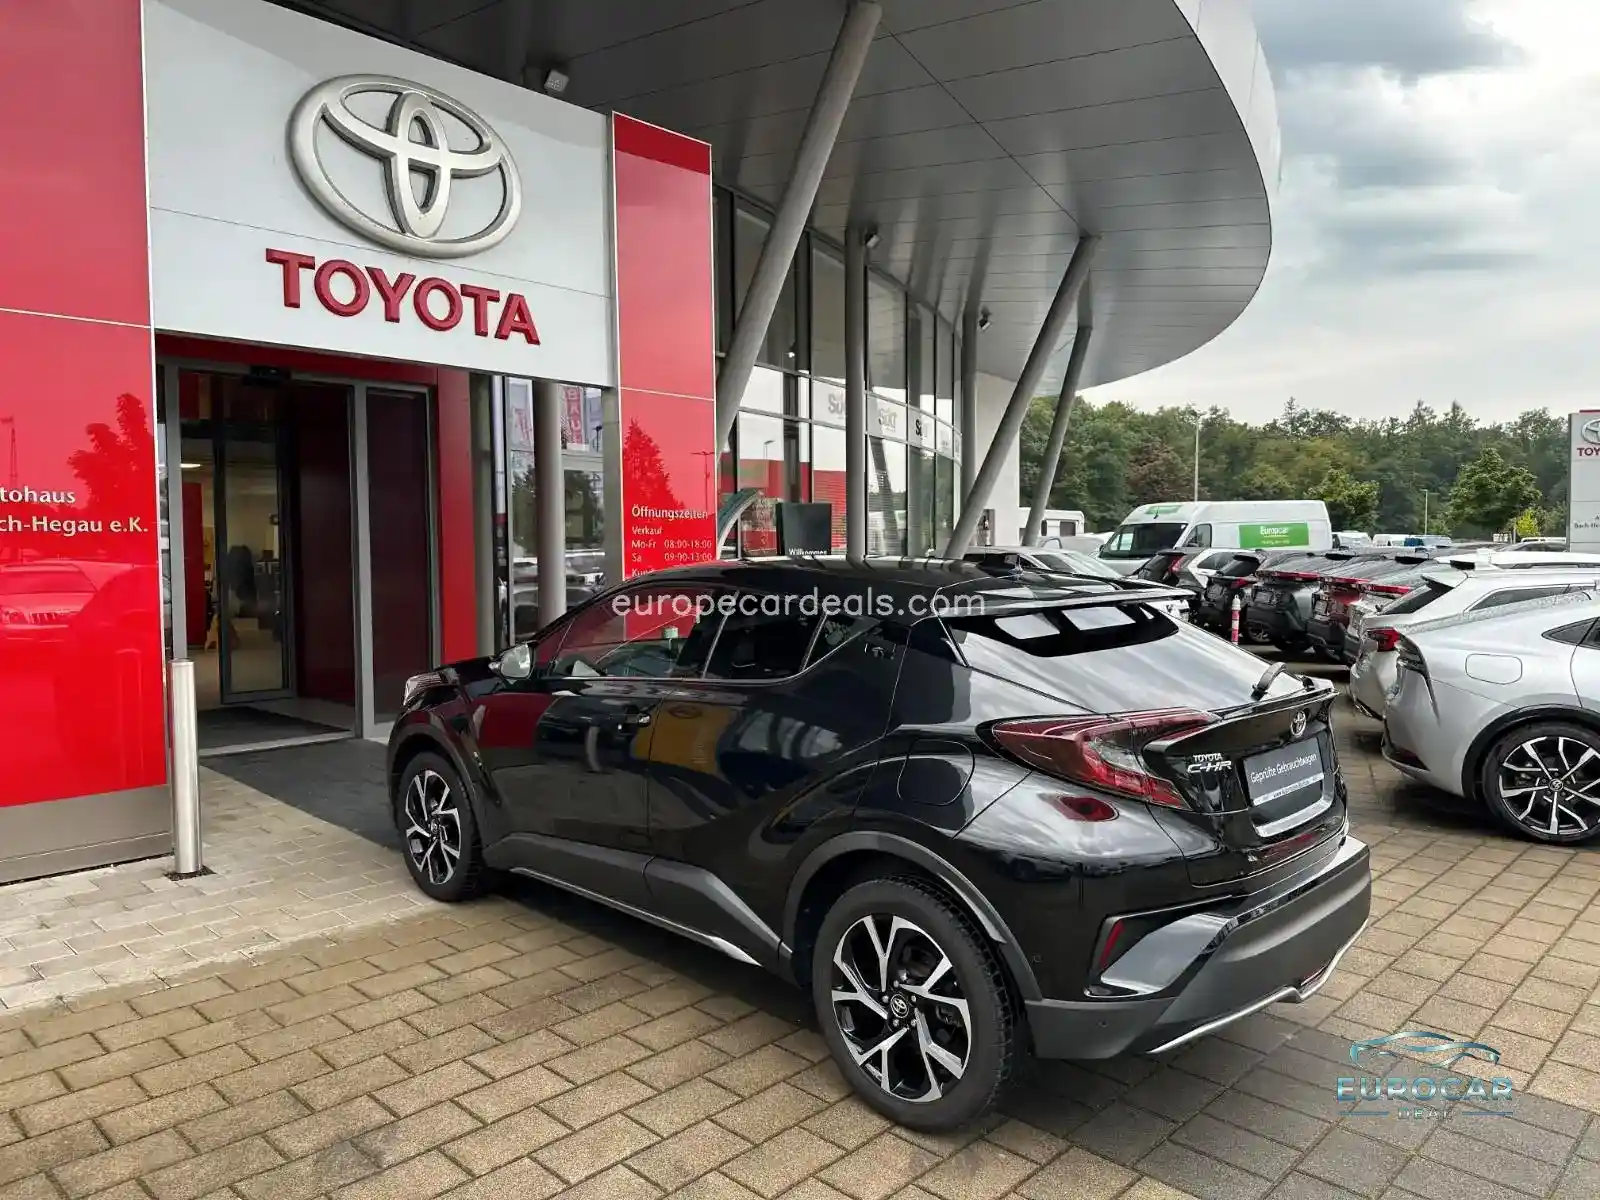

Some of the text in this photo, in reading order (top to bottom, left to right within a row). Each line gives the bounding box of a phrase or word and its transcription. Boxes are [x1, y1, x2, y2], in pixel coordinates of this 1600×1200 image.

[265, 248, 541, 345] TOYOTA
[0, 485, 76, 503] tohaus
[631, 504, 708, 521] Öffnungszeiten
[109, 516, 149, 533] e.K.
[631, 525, 663, 535] Verkauf
[631, 539, 657, 549] Mo-Fr
[631, 552, 642, 562] Sa
[1192, 752, 1223, 763] TOYOTA
[1187, 760, 1232, 774] C-HR
[1250, 753, 1318, 783] Geprüfte Gebrauchtwagen
